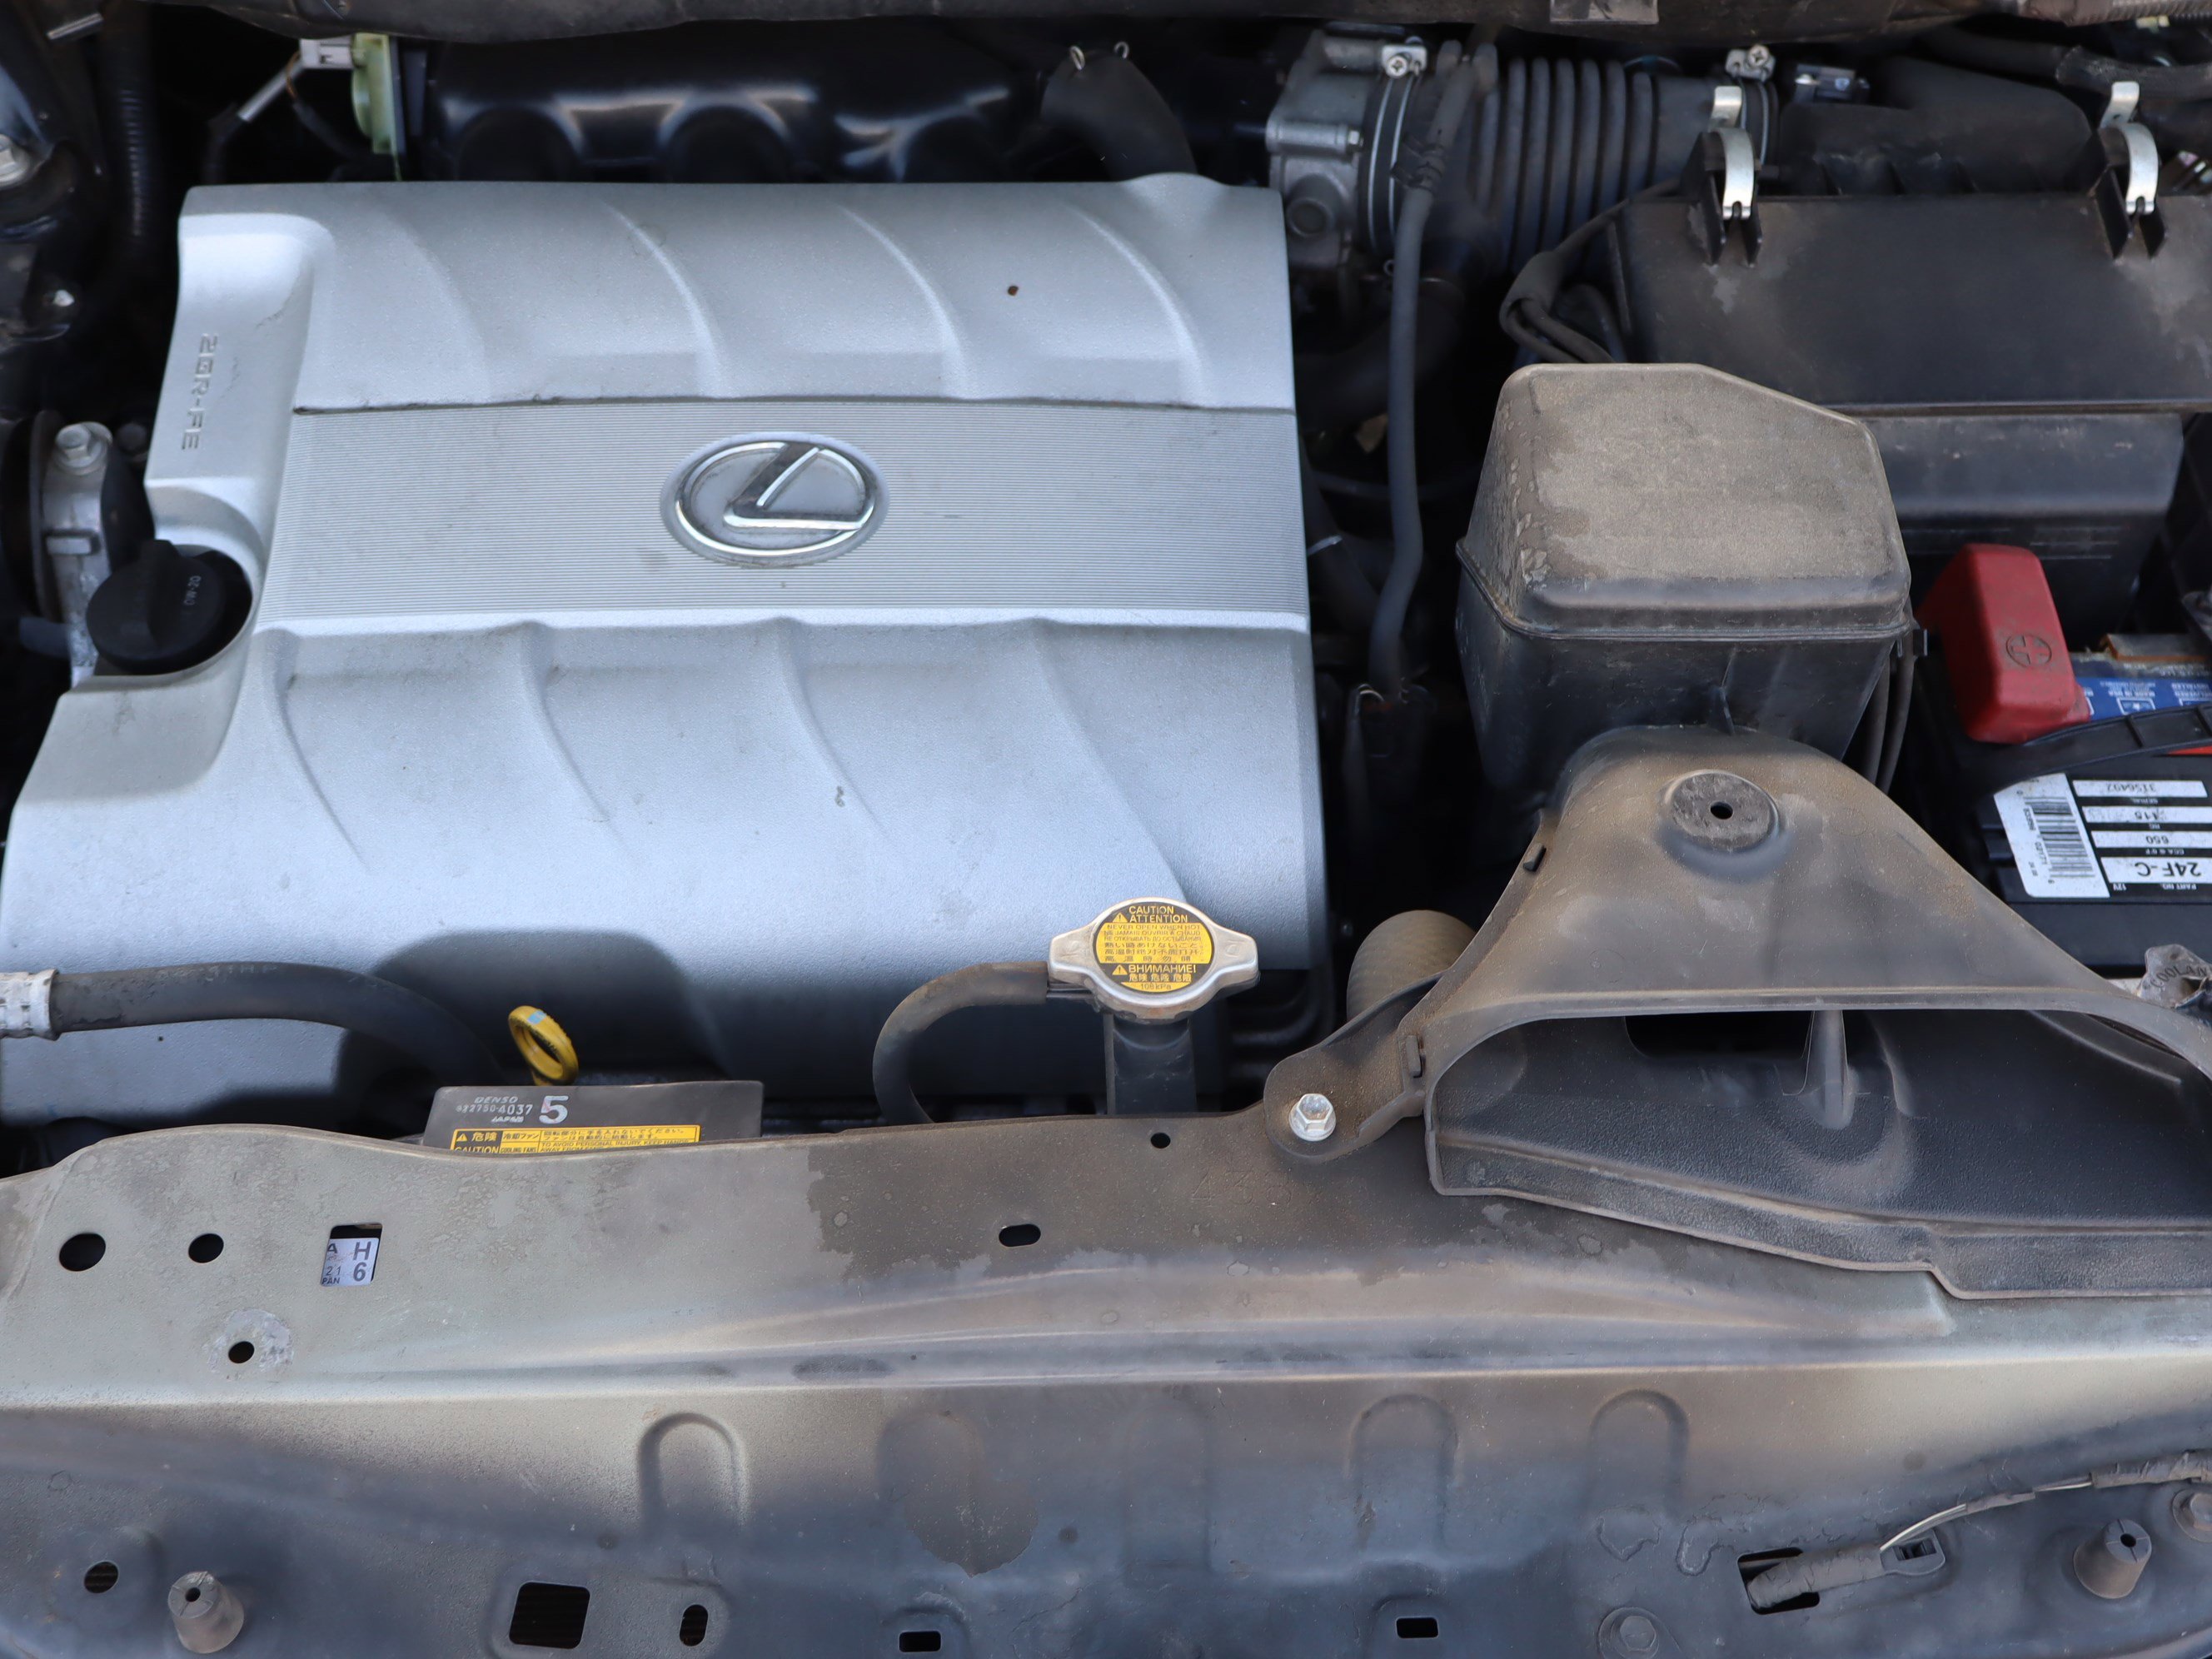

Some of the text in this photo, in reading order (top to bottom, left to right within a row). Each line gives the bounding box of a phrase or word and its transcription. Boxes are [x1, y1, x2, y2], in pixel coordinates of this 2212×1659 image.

[181, 332, 218, 451] 2GR-FE
[183, 575, 202, 606] 0W-20
[2145, 835, 2169, 844] 650
[2134, 862, 2201, 877] 24F-C
[2113, 883, 2127, 891] 12V
[1128, 905, 1174, 914] CAUTION
[1129, 914, 1188, 923] ATTENTION
[1128, 964, 1196, 973] ВНИМАНИЕ!
[539, 1095, 569, 1124] 5
[471, 1132, 498, 1142] 危険
[353, 1241, 371, 1260] H
[353, 1262, 367, 1282] 6
